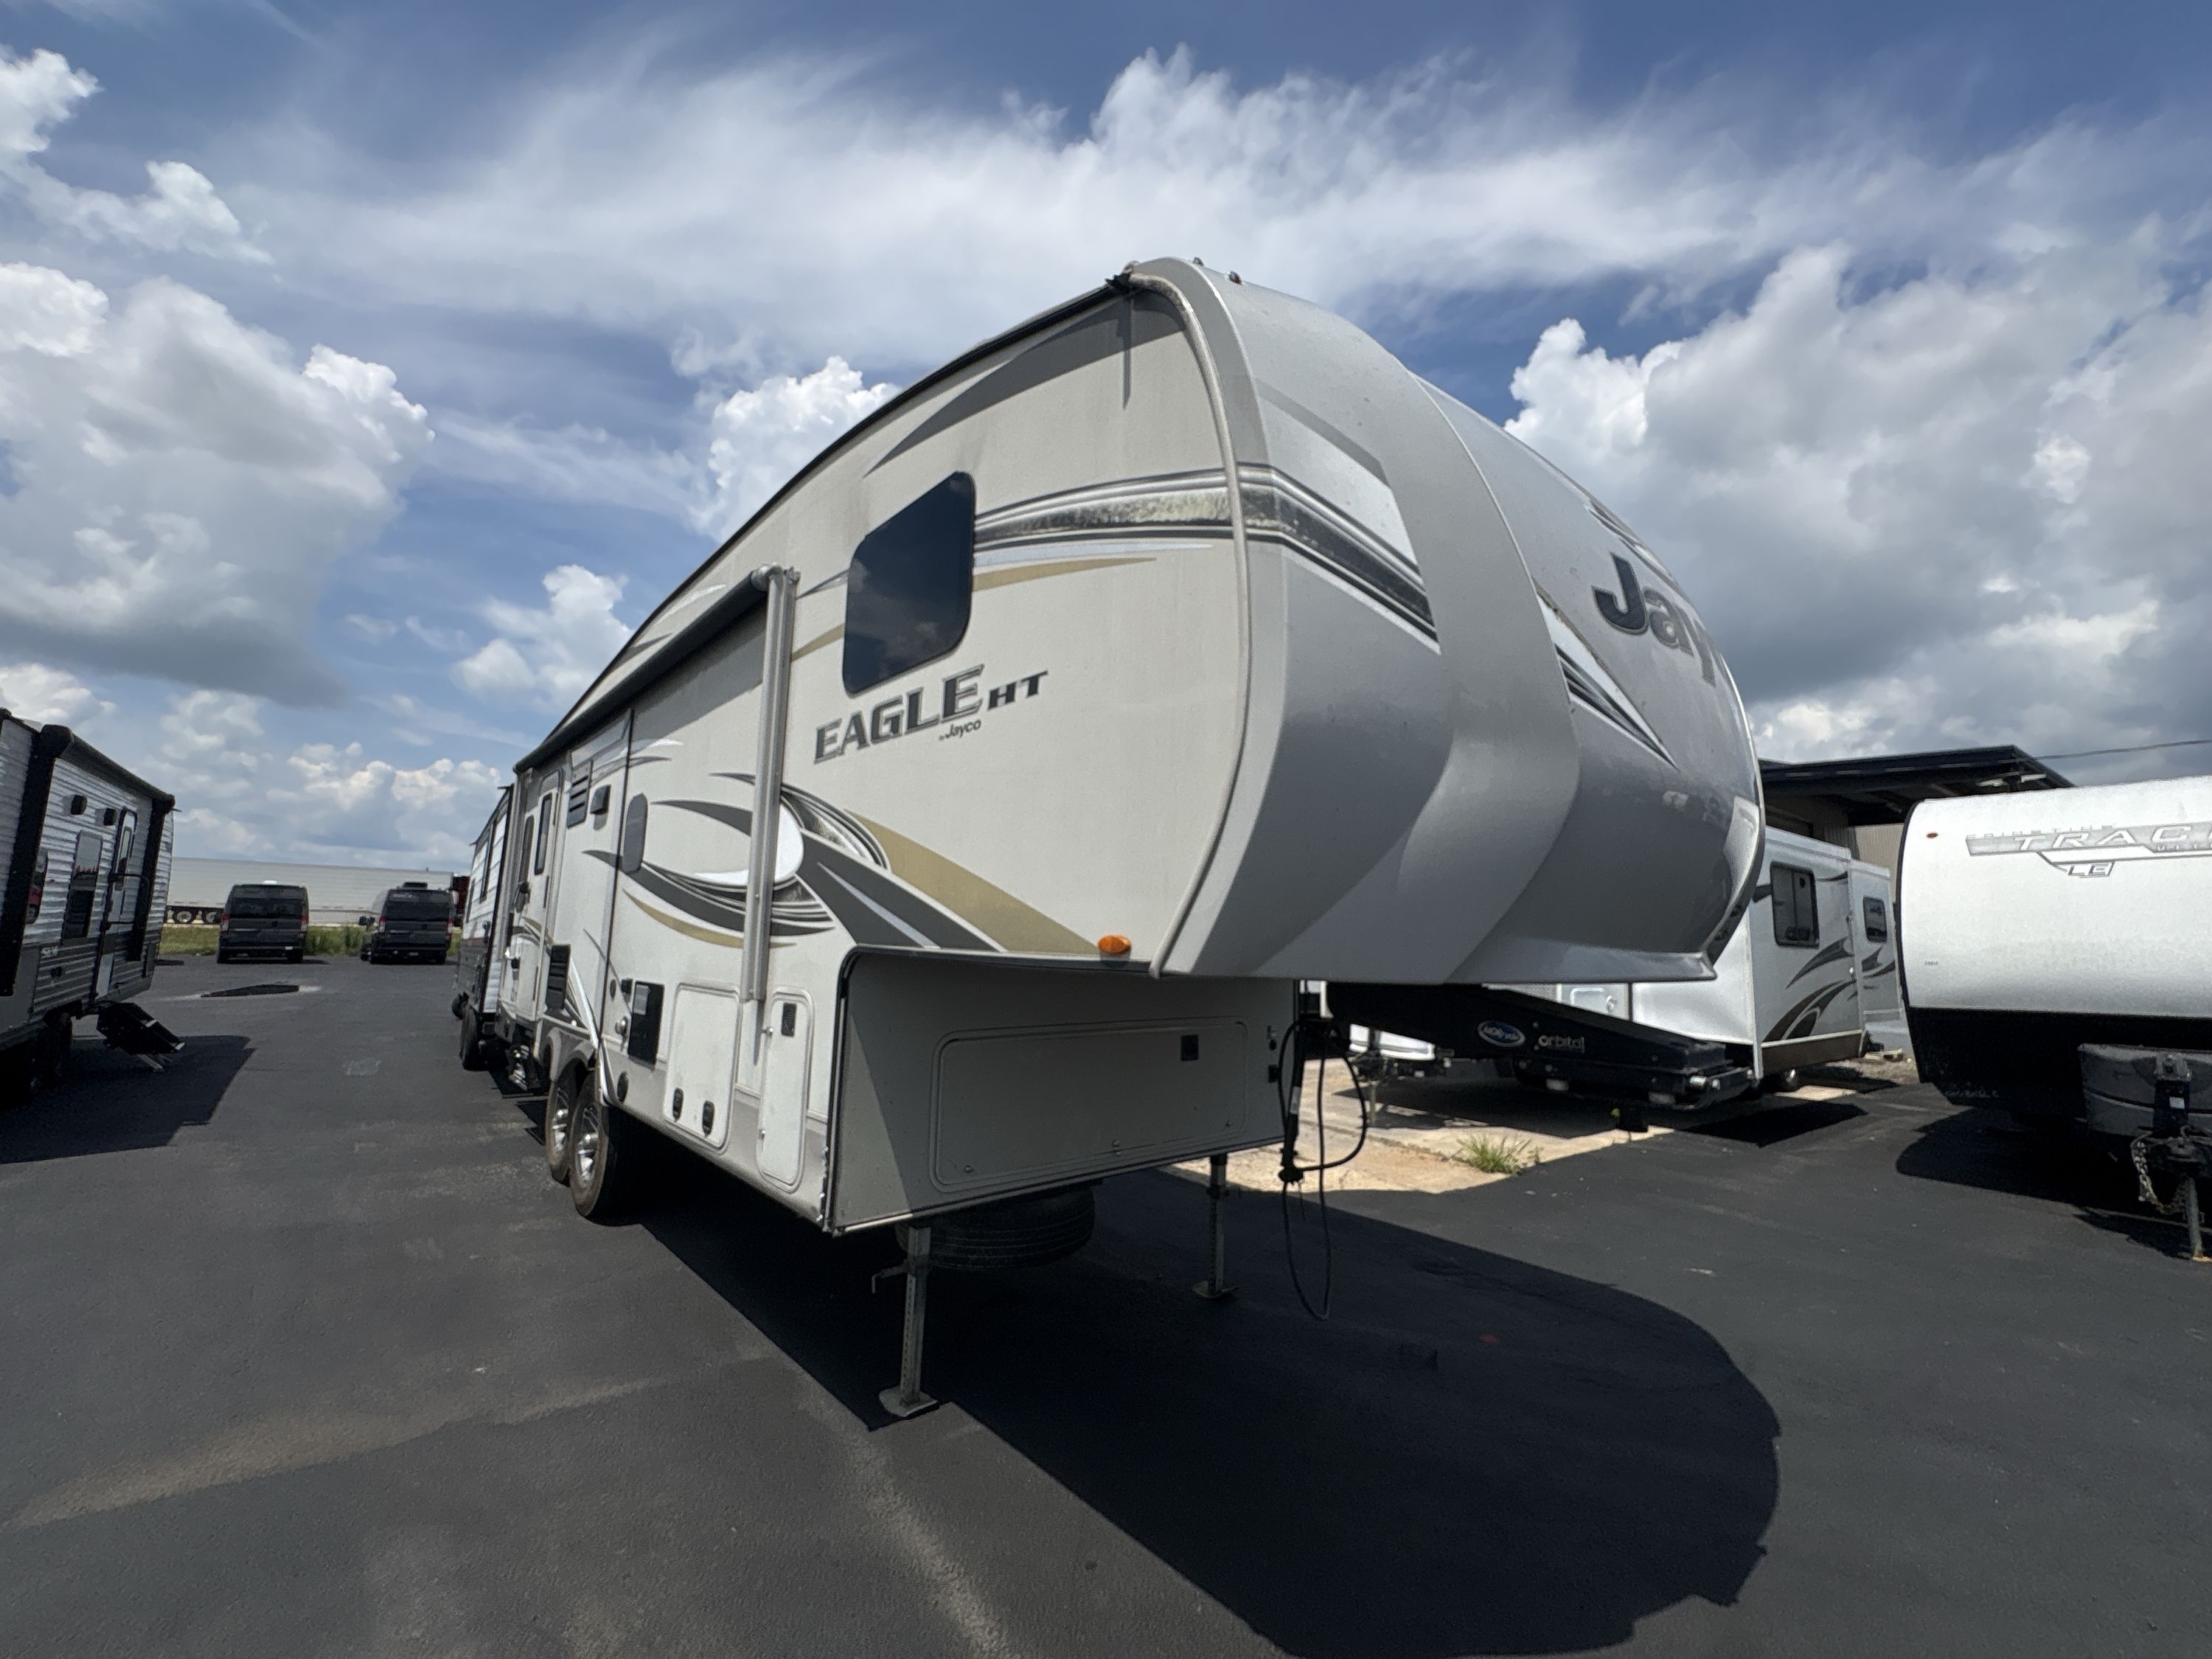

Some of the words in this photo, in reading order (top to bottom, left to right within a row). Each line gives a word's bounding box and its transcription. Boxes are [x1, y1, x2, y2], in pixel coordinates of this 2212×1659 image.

[1590, 551, 1730, 688] Jay
[813, 664, 985, 765] EAGLE
[986, 669, 1049, 712] HT
[949, 719, 982, 738] Jayco
[2014, 824, 2212, 851] TRAC
